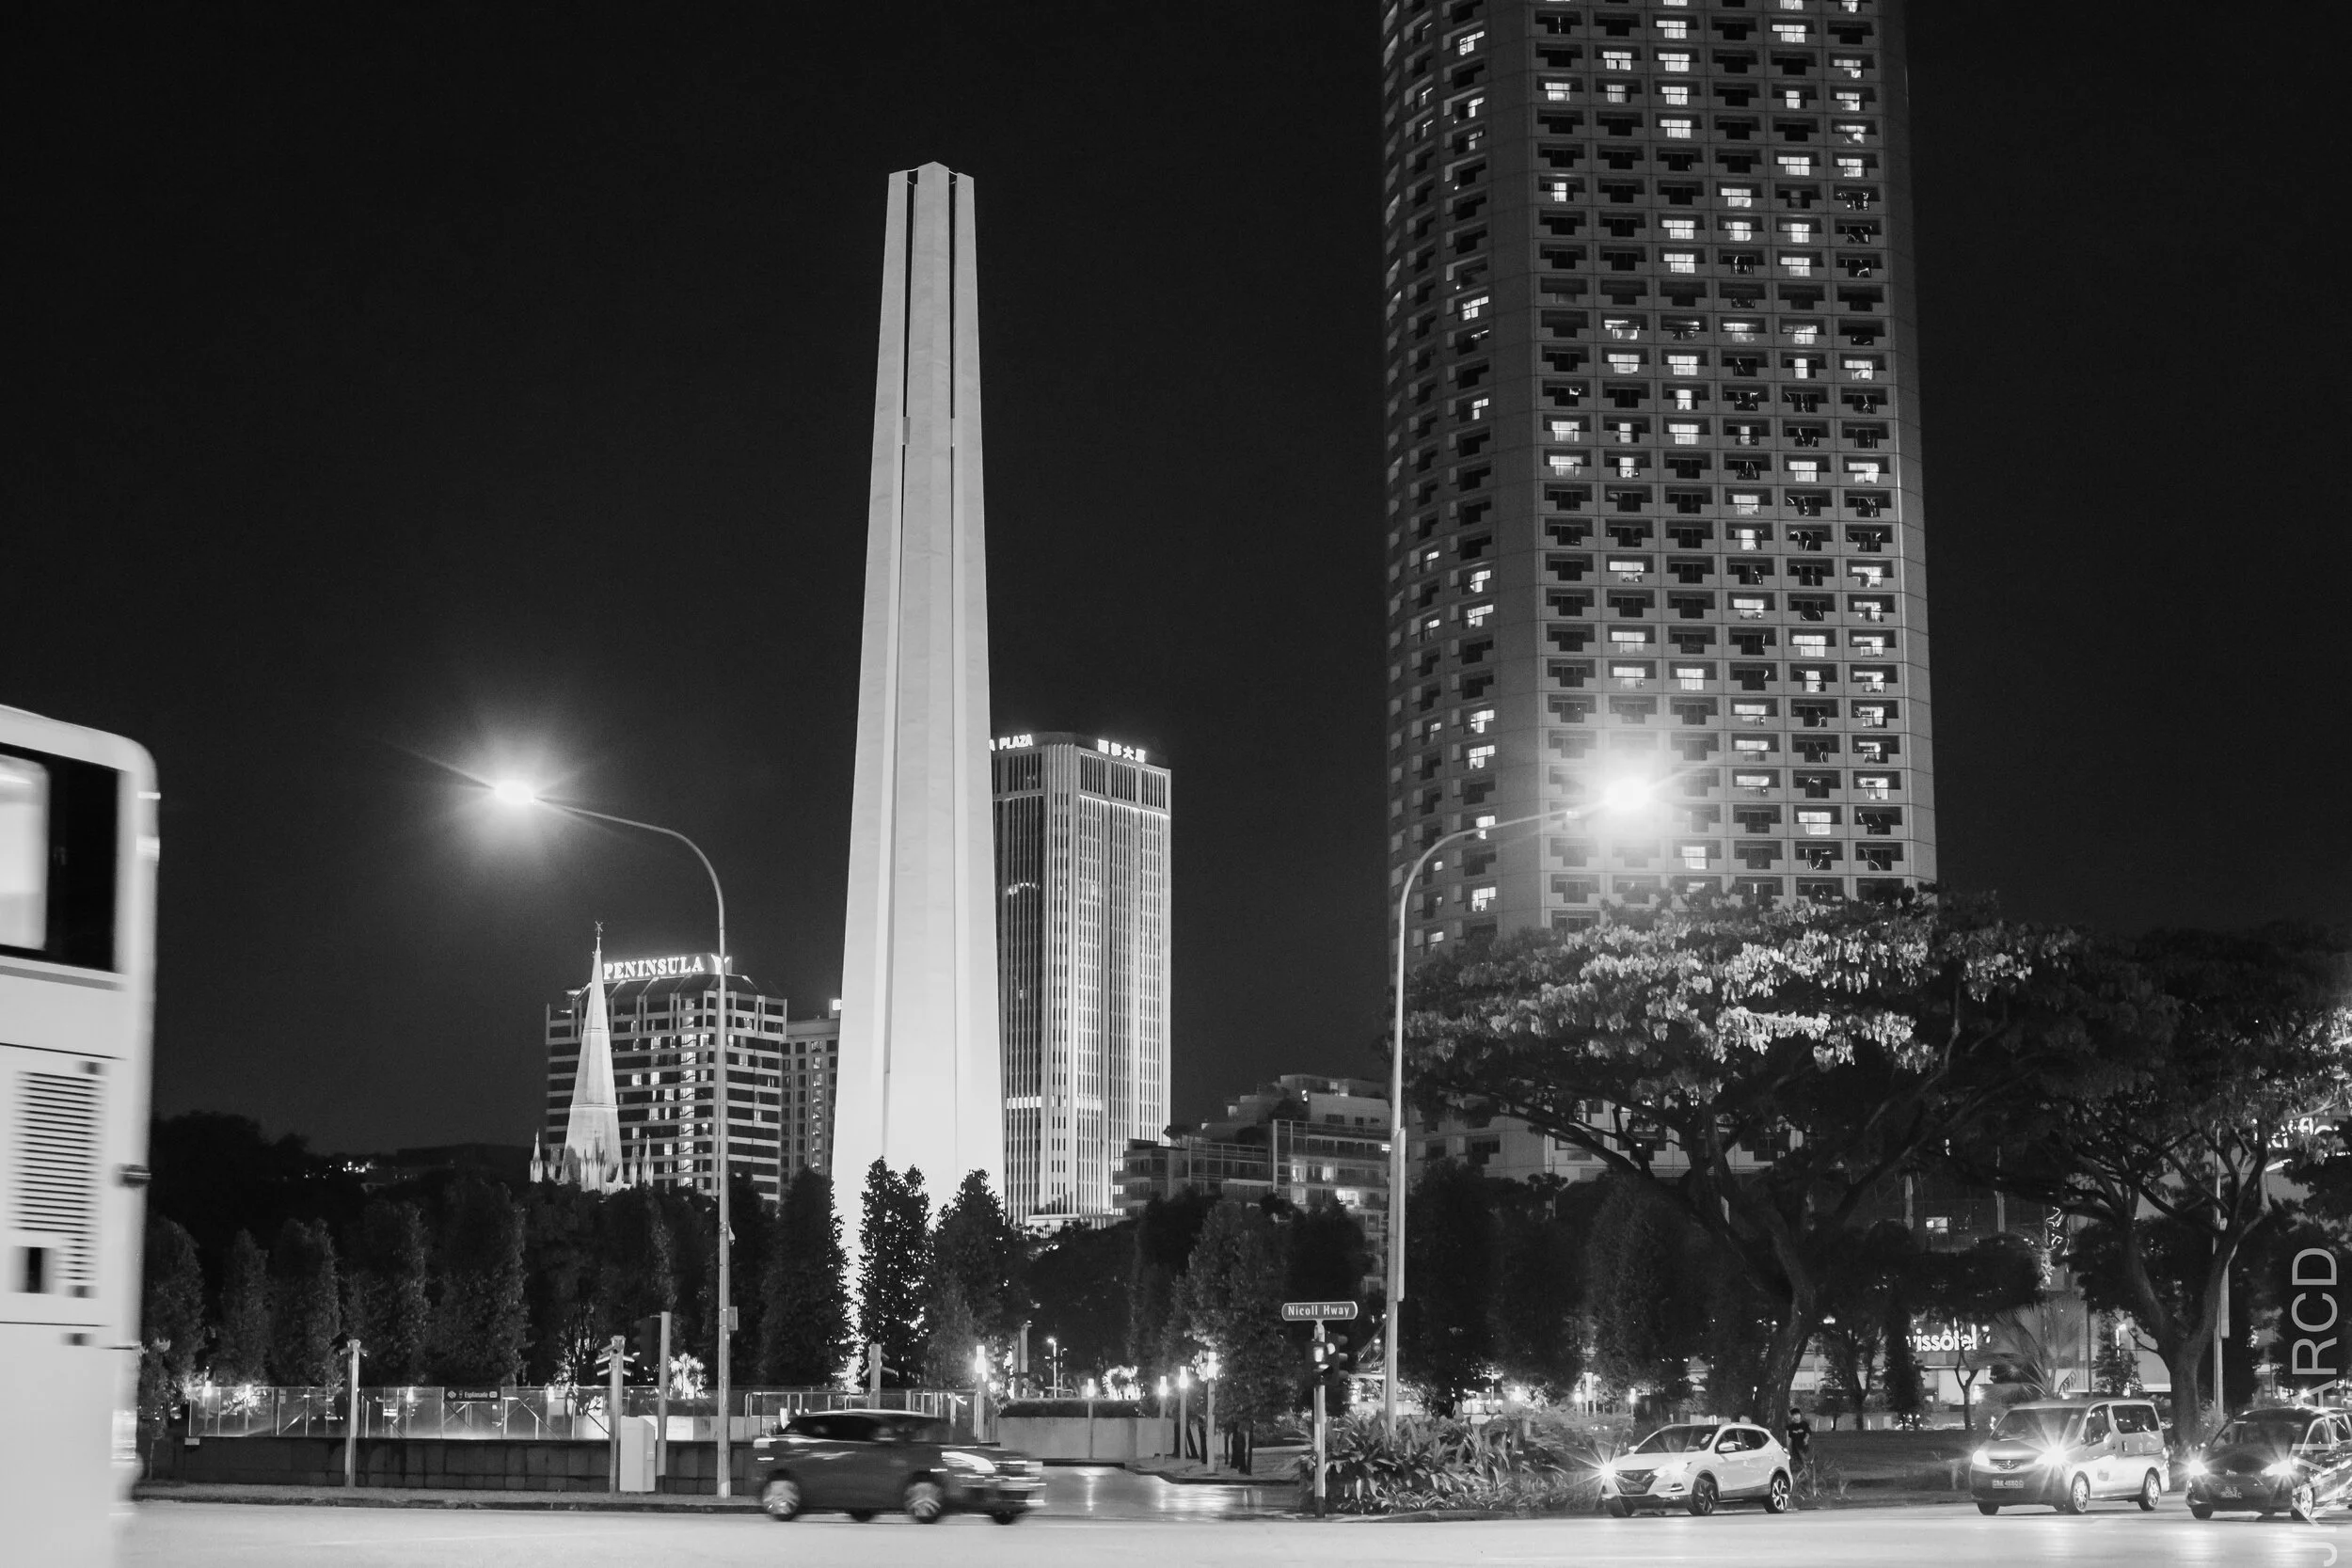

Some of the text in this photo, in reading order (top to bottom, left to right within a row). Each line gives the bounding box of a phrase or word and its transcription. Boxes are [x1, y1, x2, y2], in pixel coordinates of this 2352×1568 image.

[999, 733, 1034, 751] PLAZA
[603, 956, 705, 980] PENINSULA
[1287, 1304, 1350, 1318] Nicoll Hway
[464, 1390, 488, 1399] Esplanade
